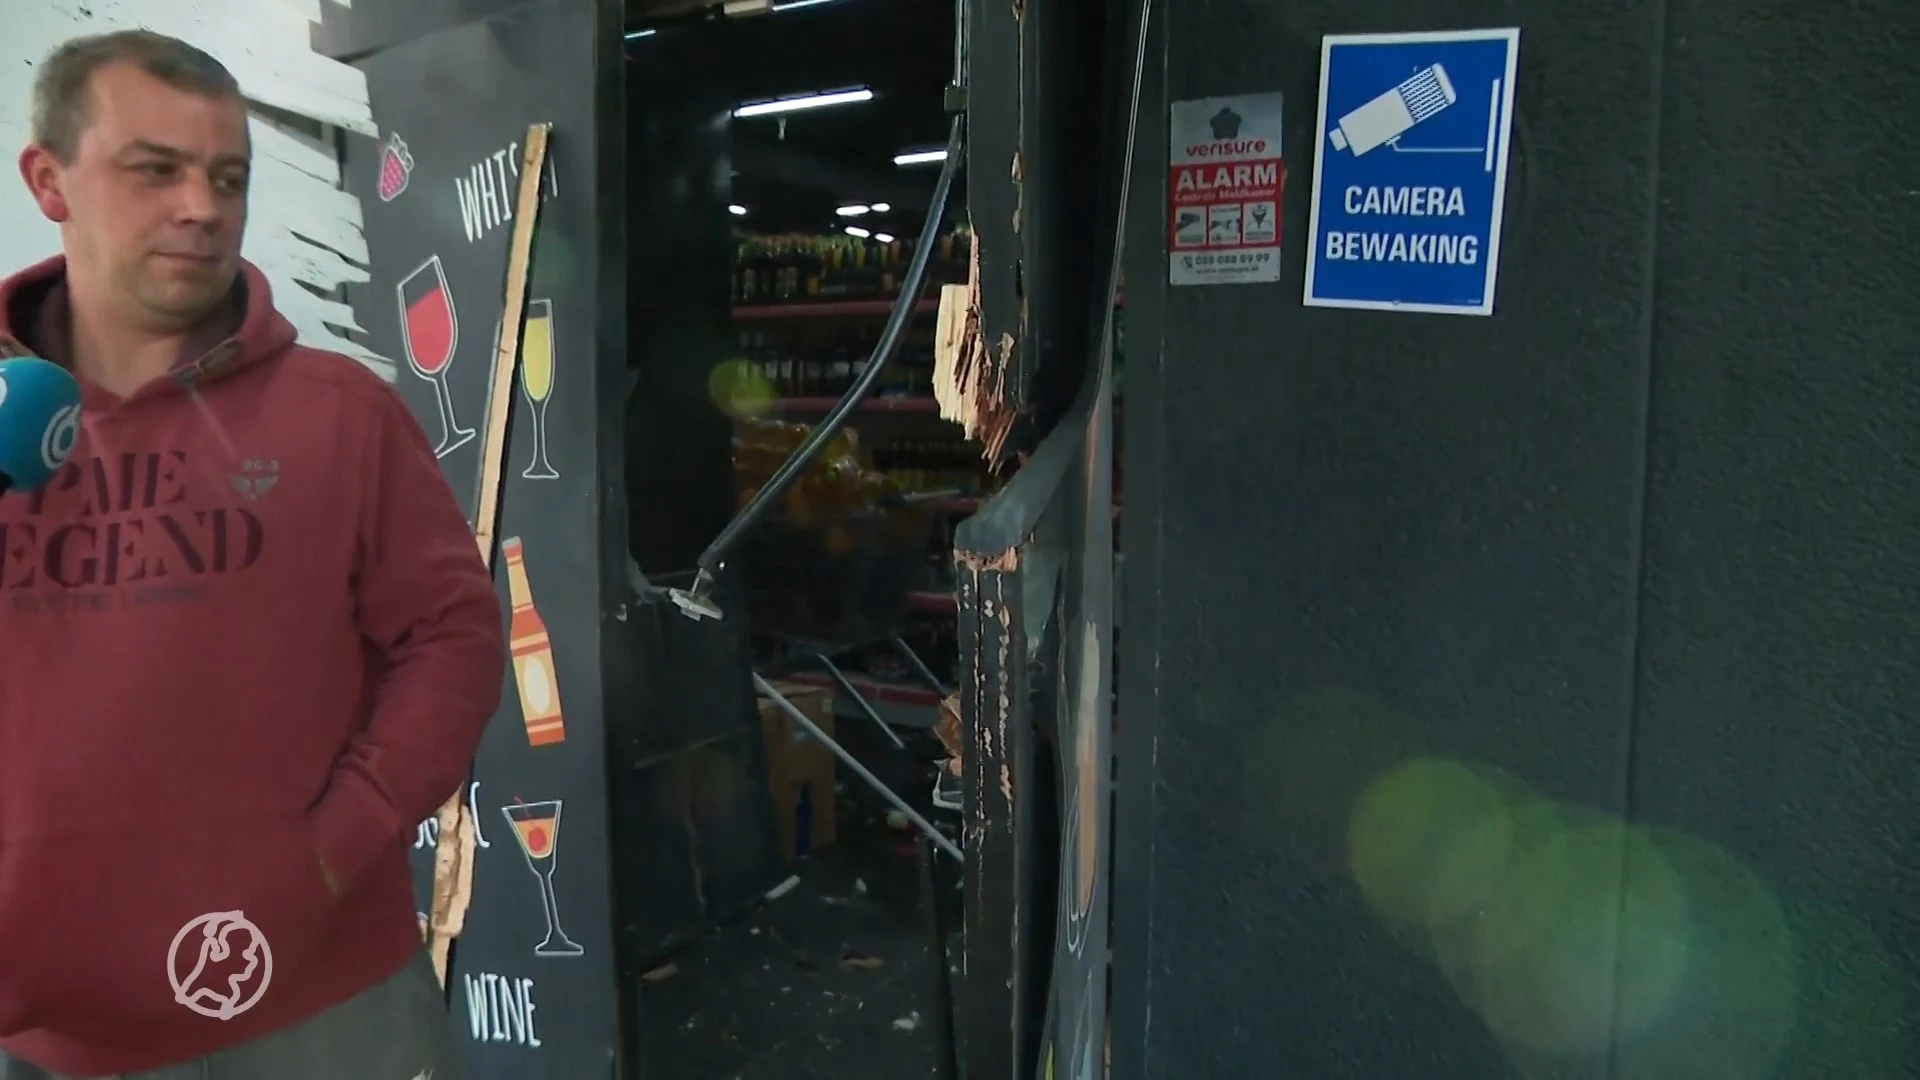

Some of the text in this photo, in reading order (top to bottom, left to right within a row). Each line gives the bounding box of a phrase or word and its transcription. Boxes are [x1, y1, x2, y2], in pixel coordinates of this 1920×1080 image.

[1185, 139, 1266, 157] verisure
[1175, 163, 1277, 193] ALARM
[1344, 185, 1465, 216] CAMERA
[1325, 231, 1479, 265] BEWAKING
[0, 508, 264, 588] EGEND
[464, 972, 541, 1048] WINE
